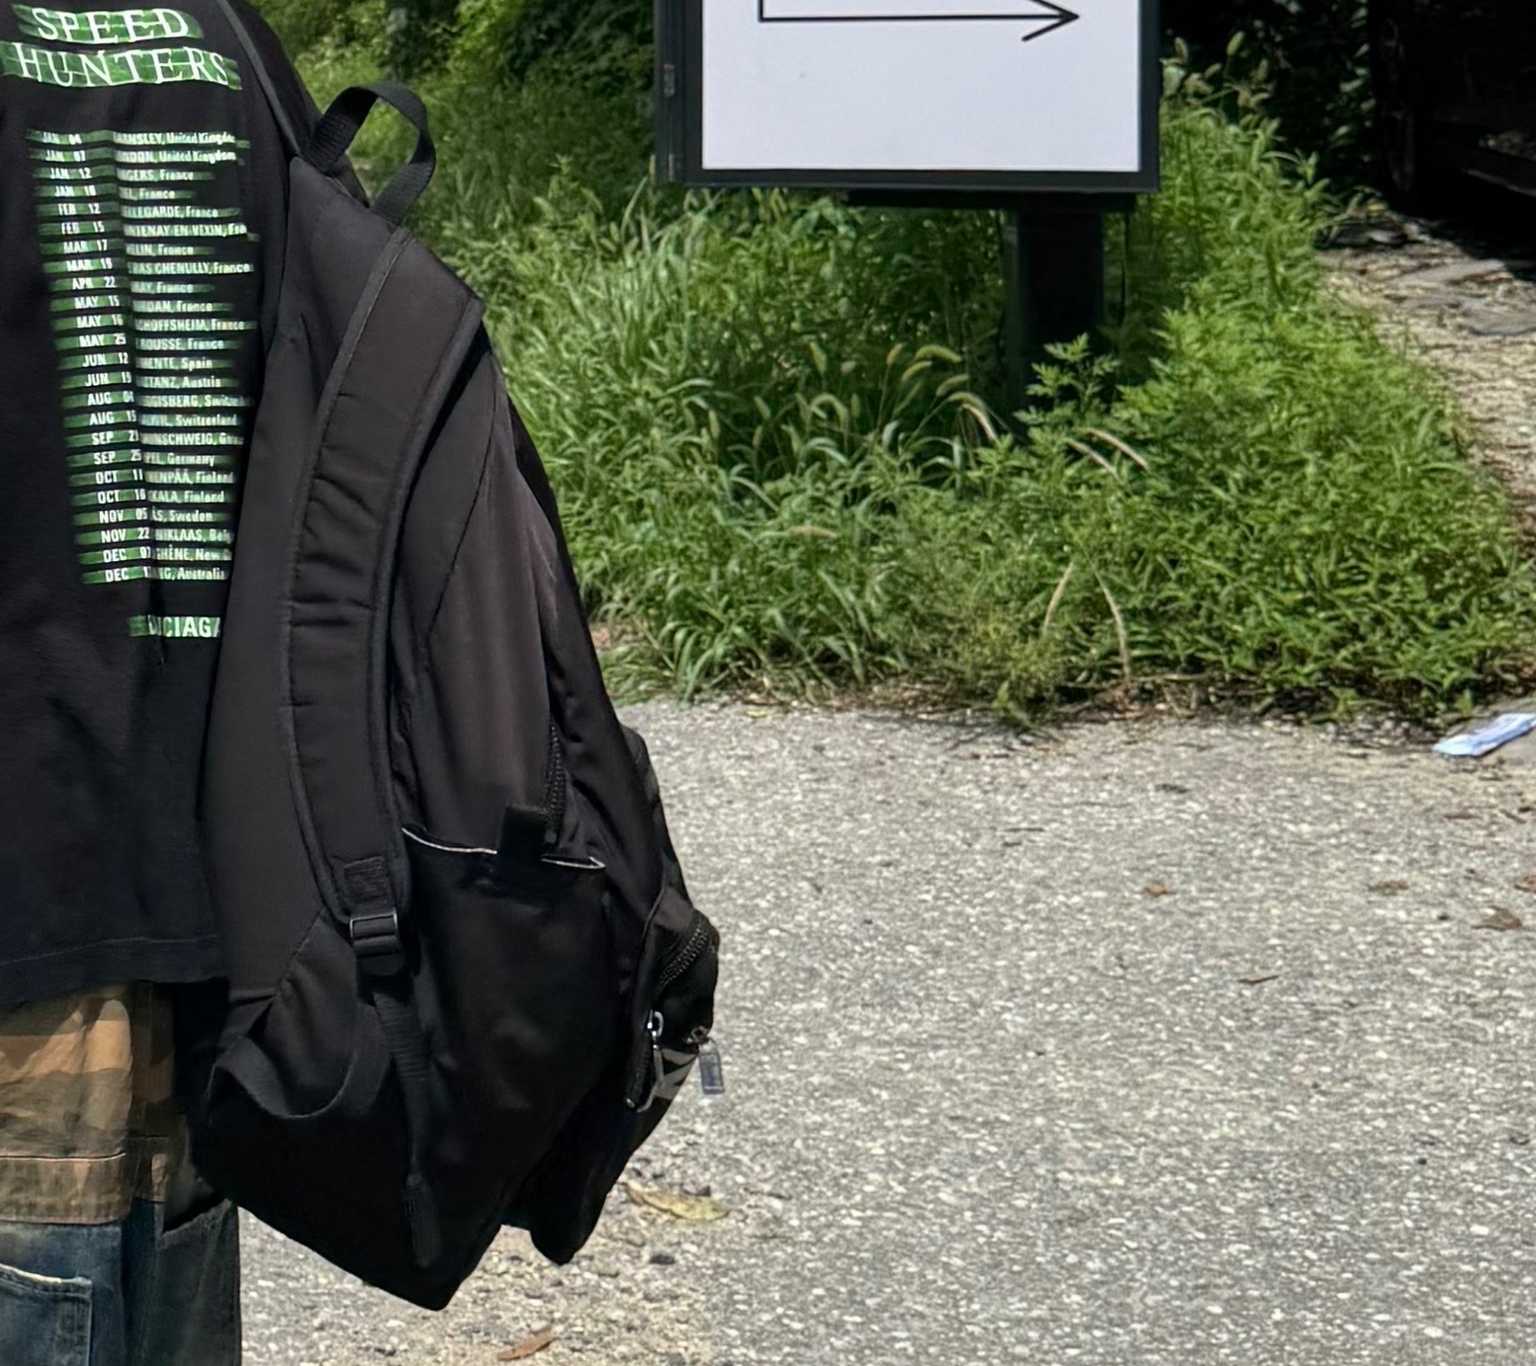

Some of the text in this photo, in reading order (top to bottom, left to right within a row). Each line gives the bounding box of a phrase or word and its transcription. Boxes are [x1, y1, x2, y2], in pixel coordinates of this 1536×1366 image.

[32, 8, 189, 43] SPEED
[12, 42, 228, 86] HUNTERS
[78, 167, 92, 179] 12
[88, 202, 101, 214] 12
[186, 206, 219, 218] France
[93, 220, 105, 233] 15
[96, 239, 108, 251] 17
[104, 276, 117, 288] 22
[74, 295, 99, 309] MAY
[108, 295, 121, 307] 15
[76, 315, 102, 329] MAY
[79, 334, 105, 348] MAY
[82, 353, 107, 367] JUN
[118, 352, 129, 364] 12
[181, 355, 213, 372] Spain
[85, 373, 110, 387] JUN
[88, 391, 113, 406] AUG
[90, 411, 115, 426] AUG
[126, 410, 137, 422] 15
[92, 431, 114, 445] SEP
[128, 429, 139, 442] 21
[94, 451, 116, 465] SEP
[96, 470, 119, 484] OCT
[132, 469, 143, 481] 11
[98, 490, 120, 504] OCT
[184, 490, 225, 503] Finland
[99, 509, 124, 523] NOV
[169, 510, 213, 522] Sweden
[101, 529, 126, 543] NOV
[137, 527, 149, 539] 22
[103, 548, 127, 563] DEC
[105, 567, 129, 582] DEC
